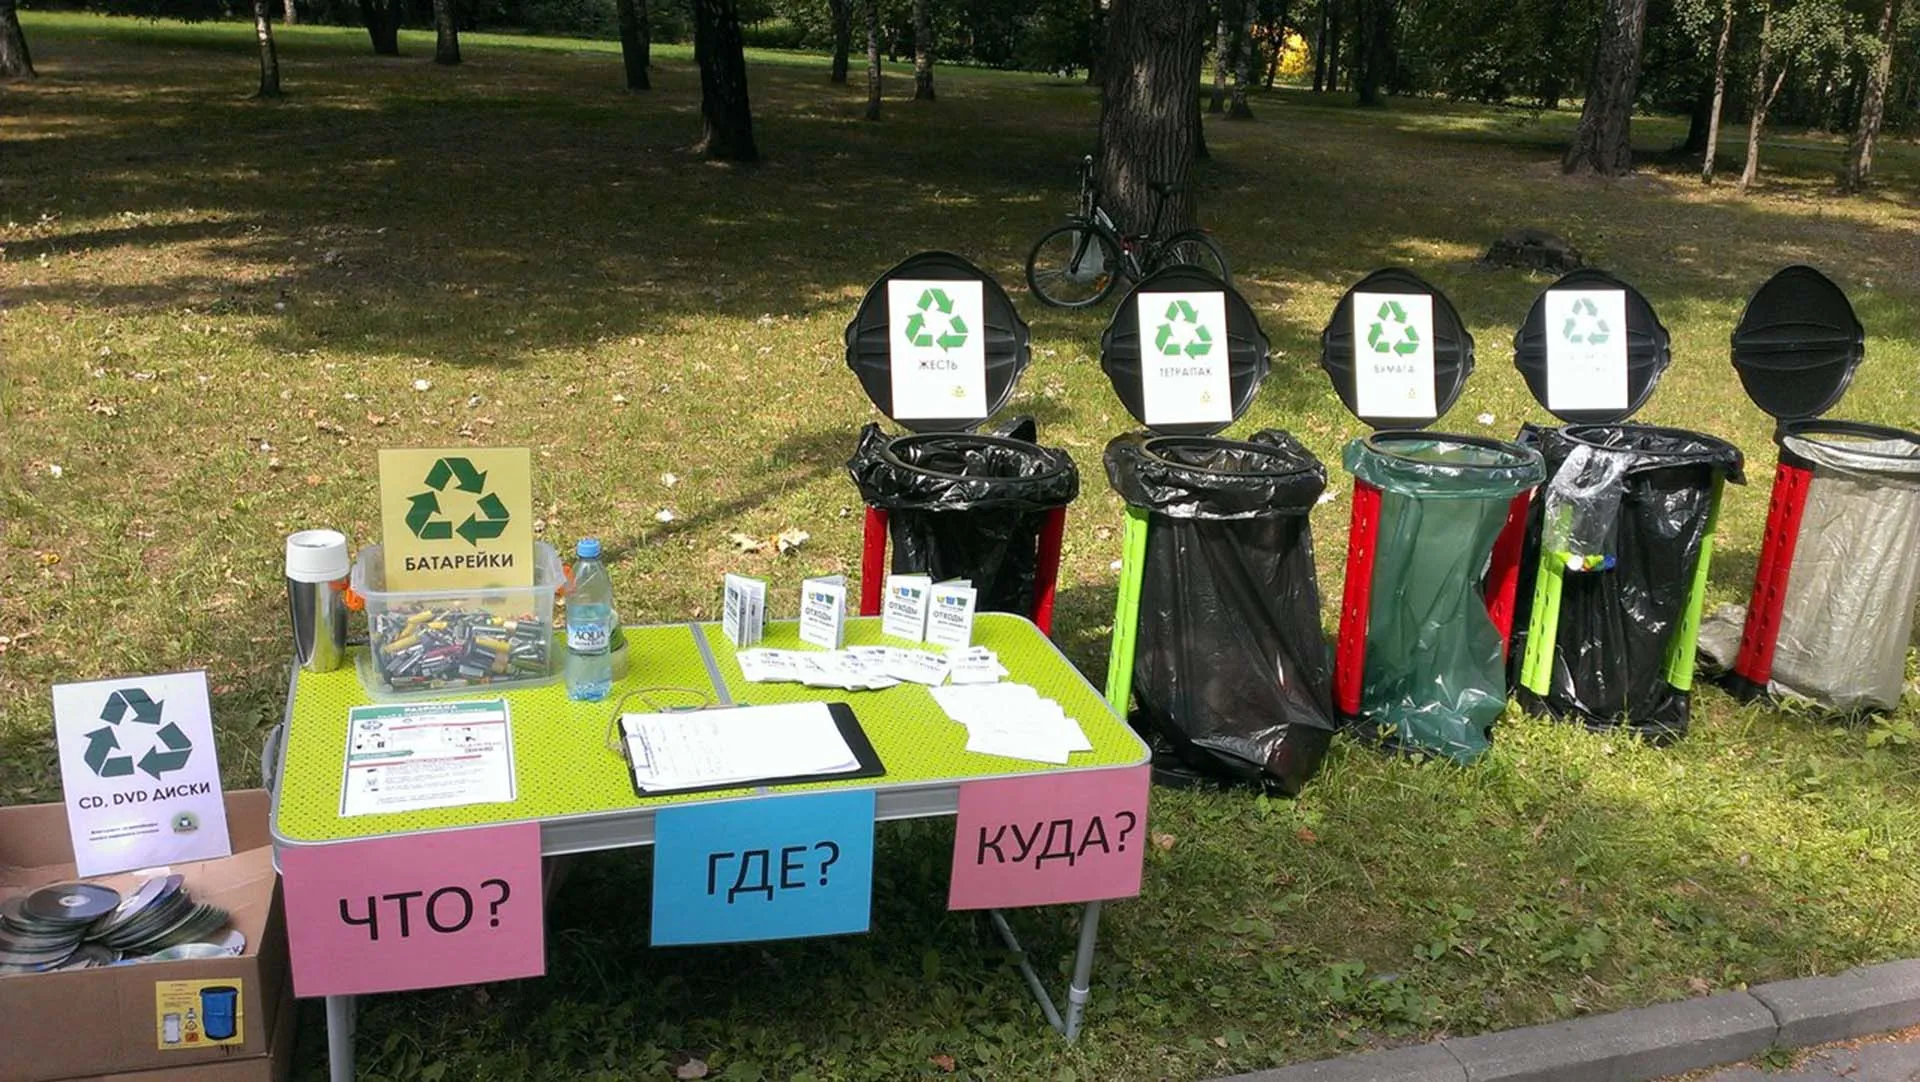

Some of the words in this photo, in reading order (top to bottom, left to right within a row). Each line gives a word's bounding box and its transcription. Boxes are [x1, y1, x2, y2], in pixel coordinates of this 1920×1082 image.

[918, 359, 958, 371] ЖЕСТЬ
[1159, 367, 1213, 378] ТЕТРАПАК
[405, 551, 514, 571] БАТАРЕЙКИ
[574, 629, 606, 642] AQUA
[78, 795, 109, 809] CD,
[112, 790, 148, 806] DVD
[152, 781, 211, 802] ДИСКИ
[977, 811, 1137, 870] КУДА?
[707, 841, 840, 904] ГДЕ?
[339, 879, 511, 941] ЧТО?
